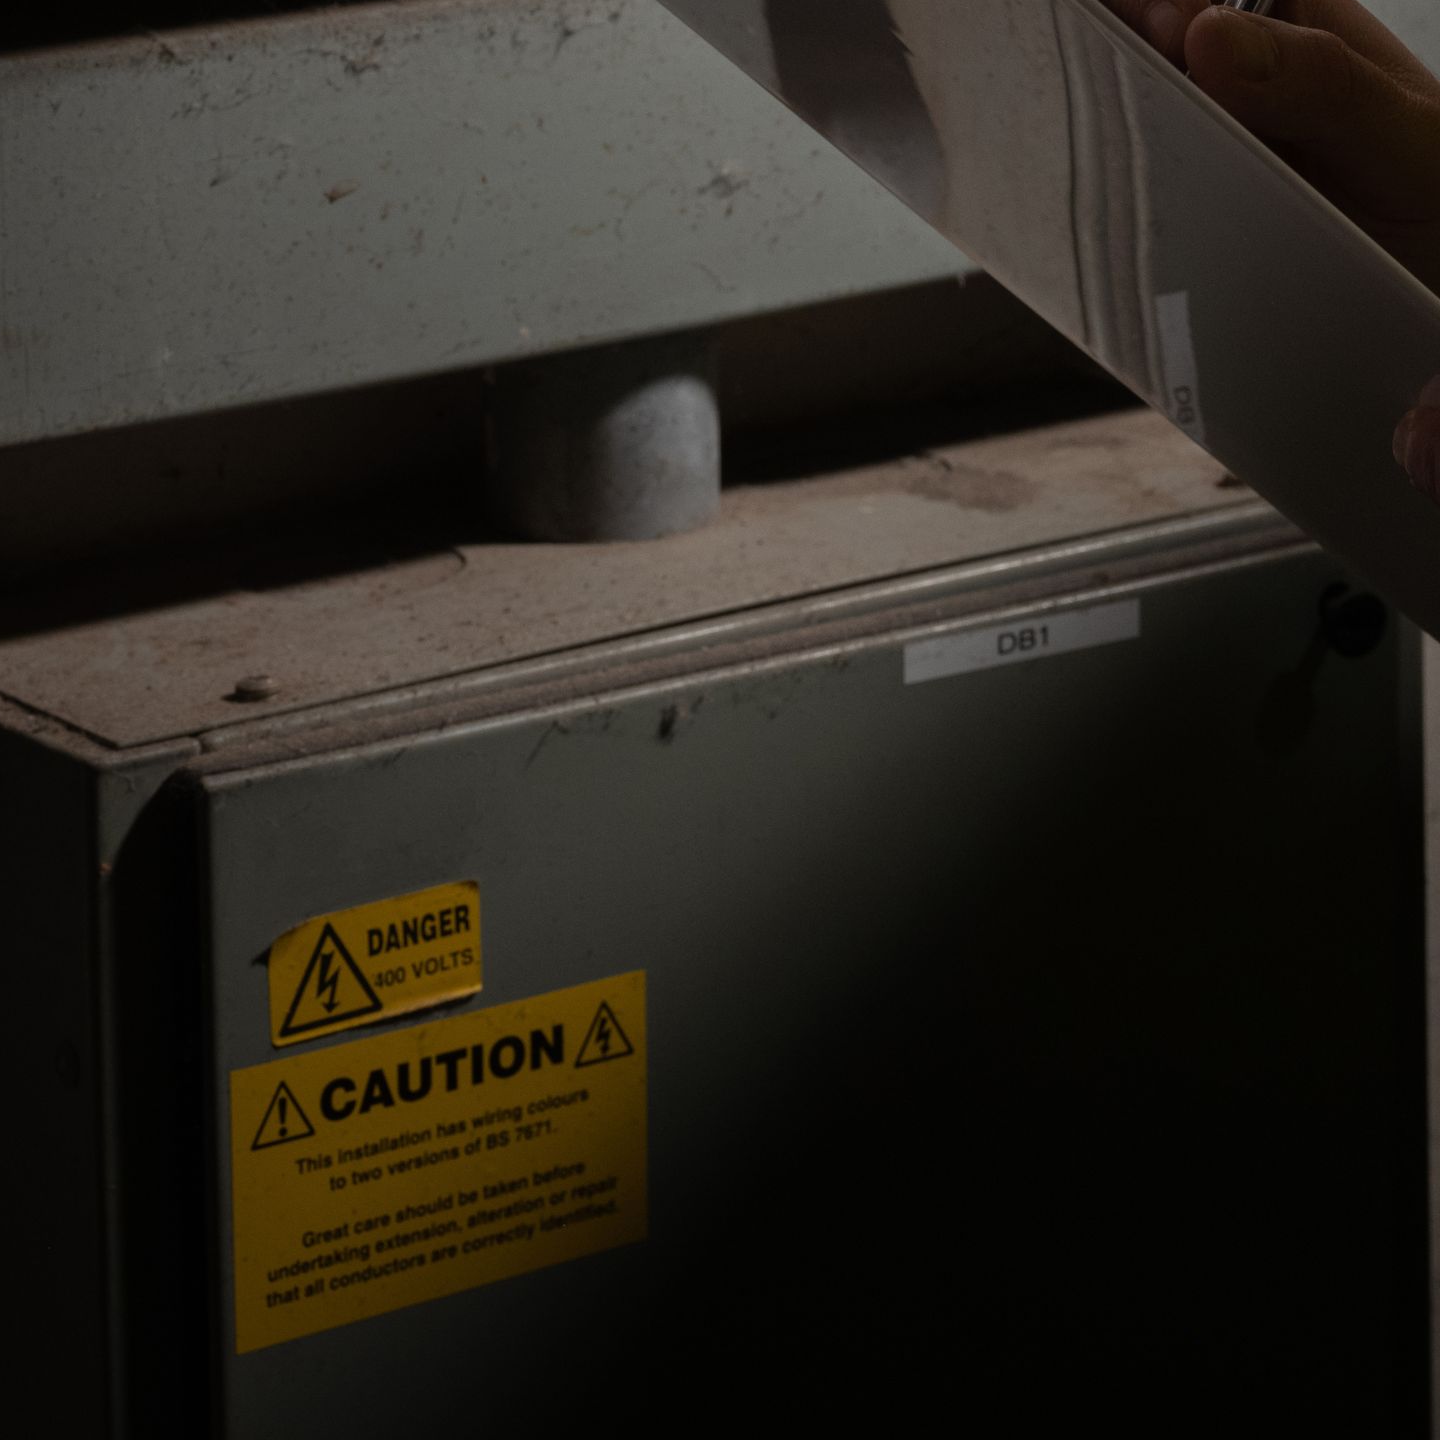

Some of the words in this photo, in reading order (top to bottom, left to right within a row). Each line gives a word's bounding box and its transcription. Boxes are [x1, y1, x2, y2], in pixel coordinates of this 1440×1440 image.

[996, 625, 1050, 656] DB1
[366, 904, 471, 957] DANGER
[371, 964, 407, 991] 400
[409, 946, 475, 979] VOLTS
[319, 1024, 565, 1122] CAUTION
[294, 1152, 333, 1175] This
[336, 1128, 432, 1165] installation
[435, 1118, 467, 1139] has
[470, 1104, 523, 1130] wiring
[525, 1087, 590, 1116] colours
[328, 1174, 348, 1192] to
[349, 1165, 383, 1186] two
[385, 1145, 461, 1176] versions
[462, 1135, 482, 1157] of
[484, 1129, 511, 1151] BS
[266, 1242, 371, 1284] undertaking
[465, 1195, 545, 1229] alteration
[548, 1189, 567, 1207] or
[569, 1176, 617, 1200] repair
[300, 1221, 350, 1249] Great
[352, 1212, 392, 1236] care
[394, 1193, 454, 1224] should
[456, 1189, 479, 1208] be
[481, 1176, 529, 1200] taken
[531, 1161, 586, 1187] before
[264, 1284, 300, 1309] that
[302, 1276, 325, 1299] all
[327, 1252, 427, 1292] conductors
[429, 1243, 459, 1264] are
[460, 1222, 536, 1255] correctly
